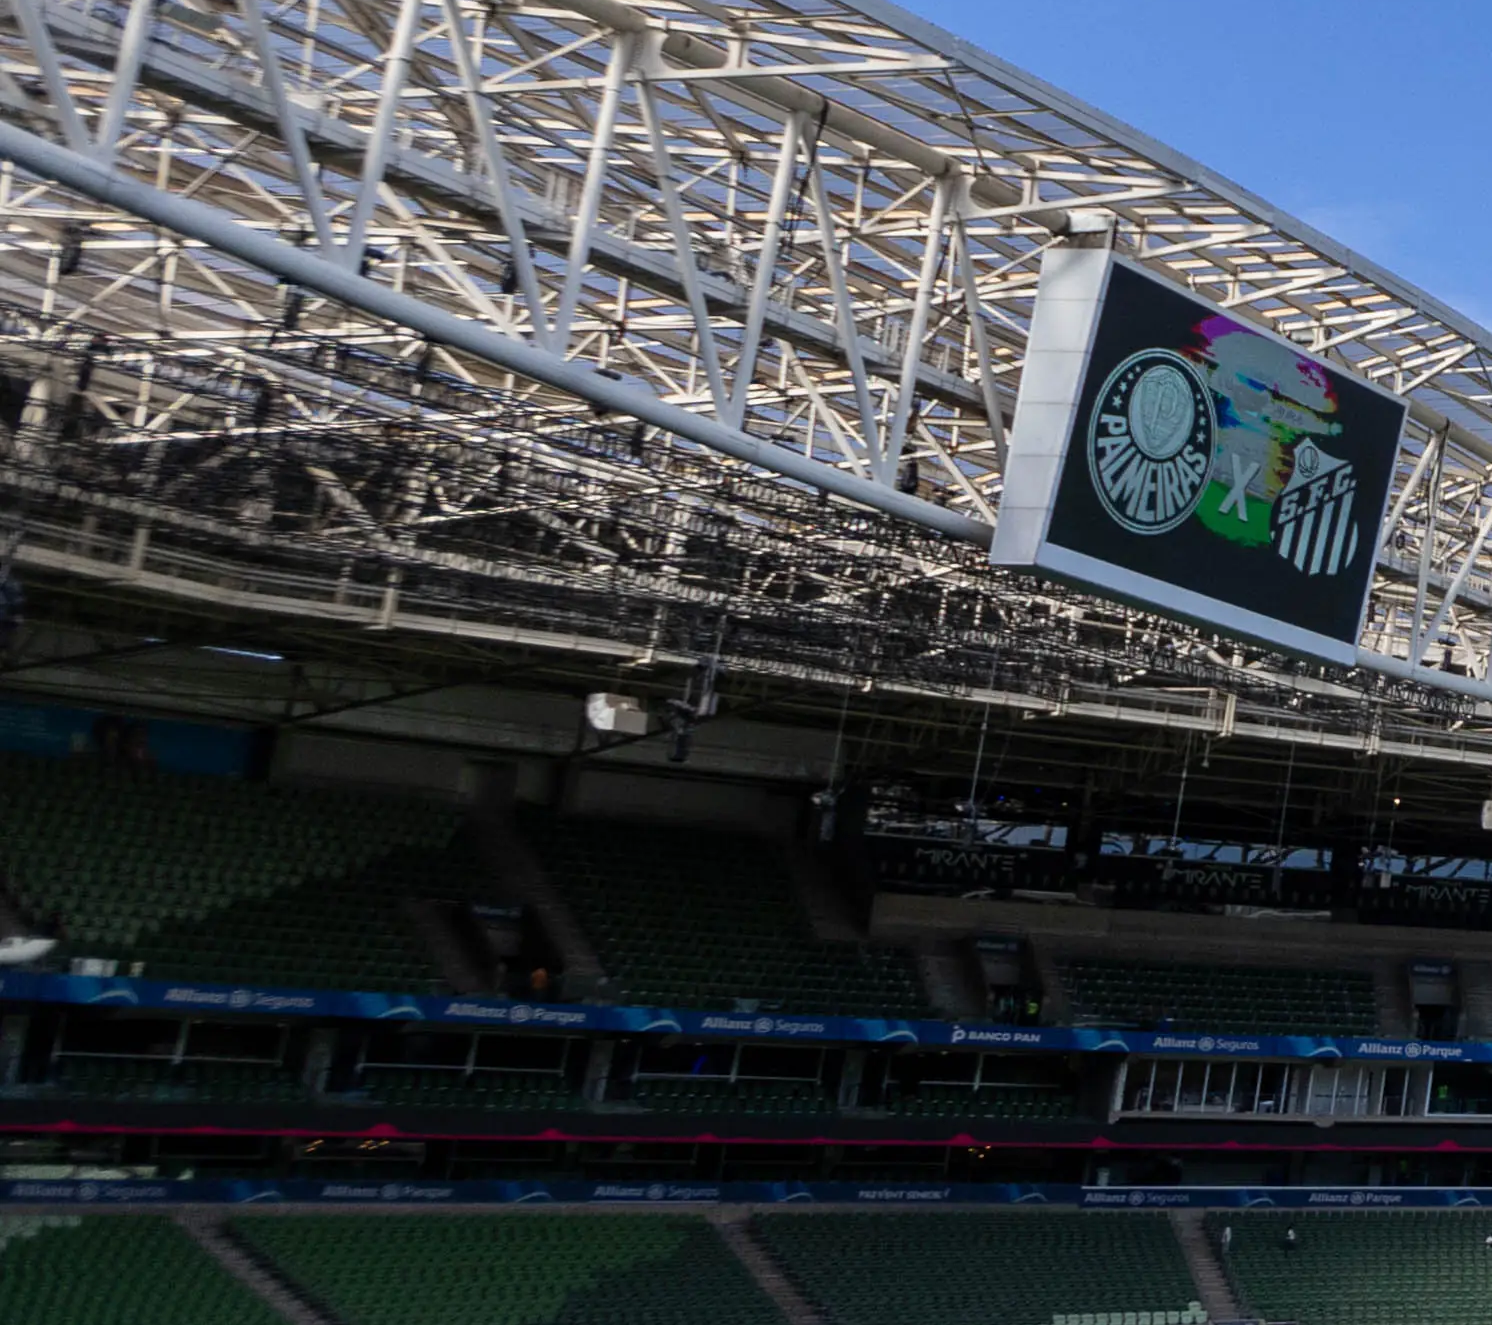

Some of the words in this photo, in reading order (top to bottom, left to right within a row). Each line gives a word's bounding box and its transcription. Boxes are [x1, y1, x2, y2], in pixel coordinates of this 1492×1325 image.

[1098, 411, 1210, 523] PALMEIRAS
[444, 1002, 506, 1019] Allianz
[533, 1005, 587, 1024] Parque
[702, 1016, 754, 1031] Allianz
[770, 1017, 825, 1034] Seguros
[967, 1030, 1010, 1044] BANCO
[1013, 1032, 1041, 1044] PAN
[1358, 1042, 1405, 1055] Allianz
[1421, 1045, 1462, 1060] Parque
